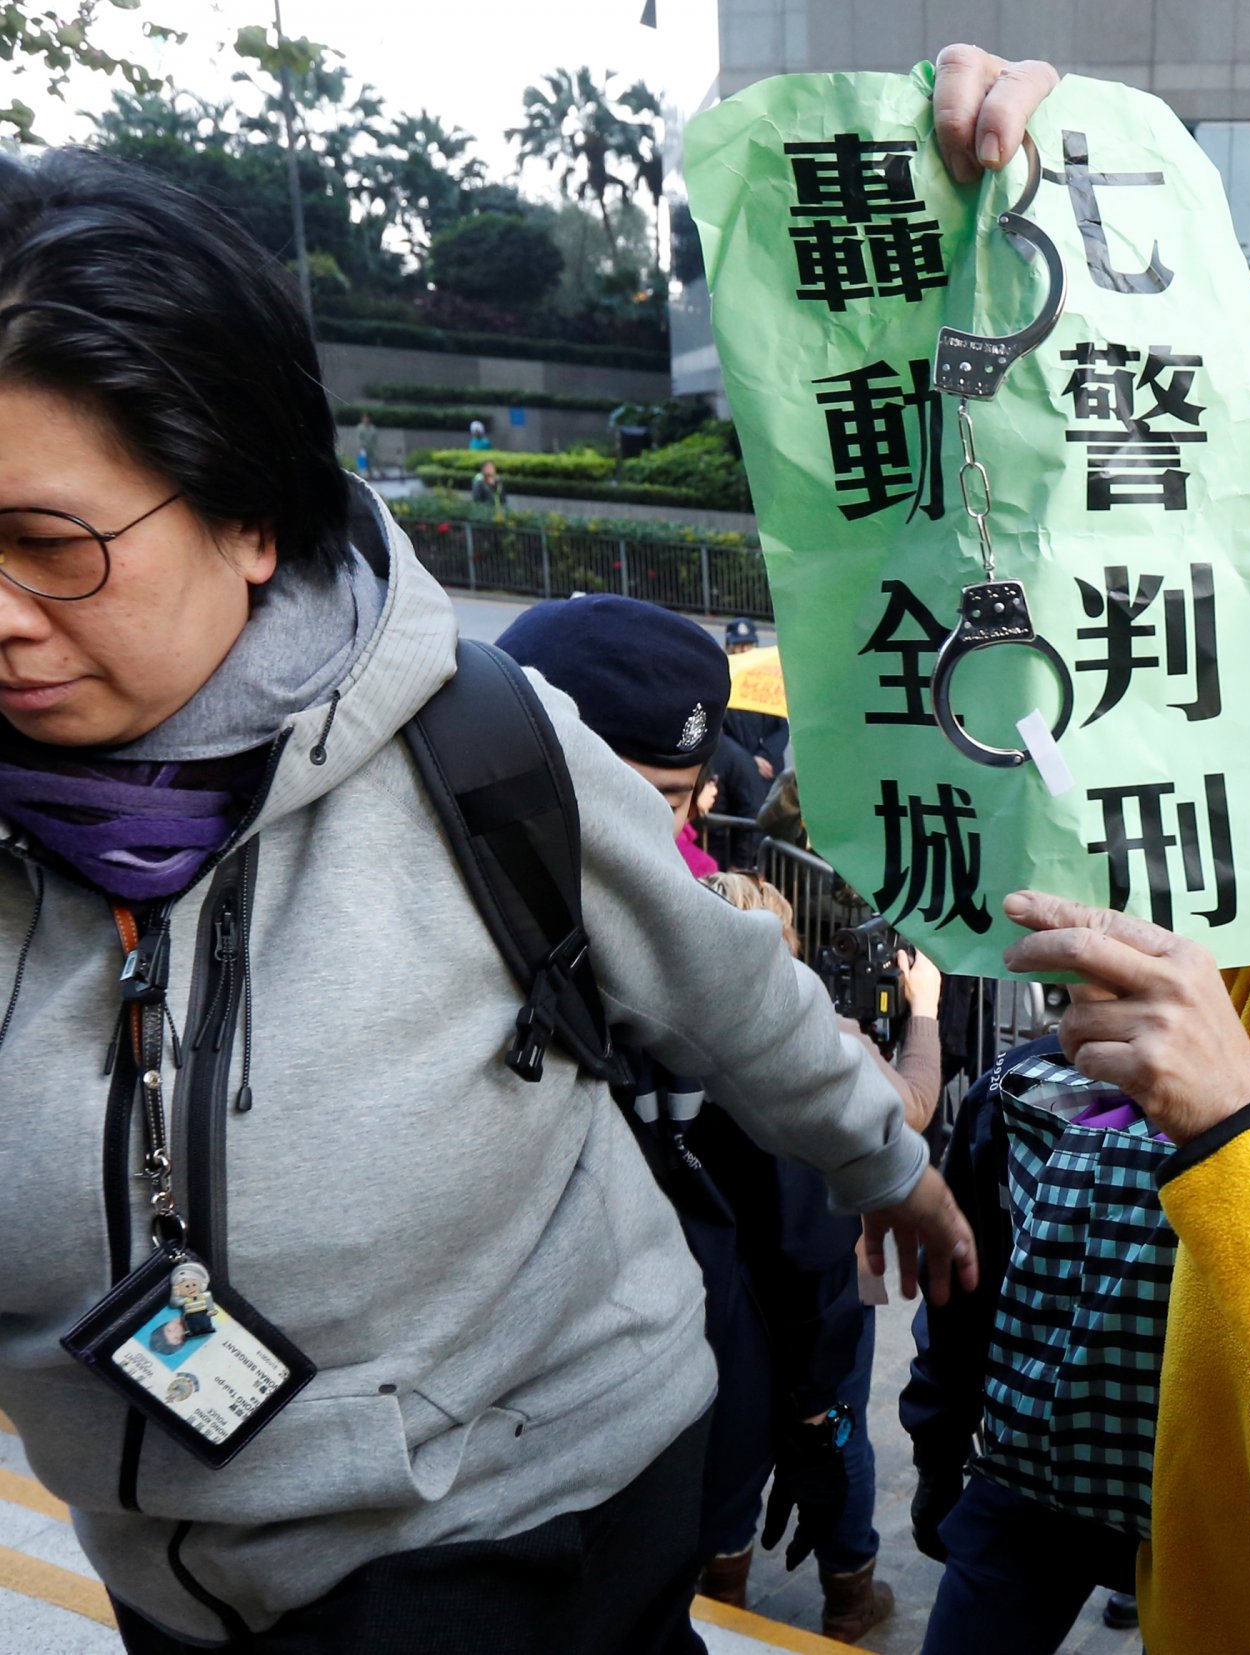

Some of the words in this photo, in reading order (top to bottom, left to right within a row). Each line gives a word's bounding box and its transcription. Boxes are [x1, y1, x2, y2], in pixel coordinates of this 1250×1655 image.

[783, 133, 993, 935] 轟動全城
[1041, 130, 1239, 930] 七警判刑
[990, 1052, 1007, 1091] 19920
[221, 1339, 258, 1371] SERGEANT
[193, 1407, 212, 1424] KONG
[206, 1407, 228, 1426] POLICE
[209, 1420, 228, 1438] HONG
